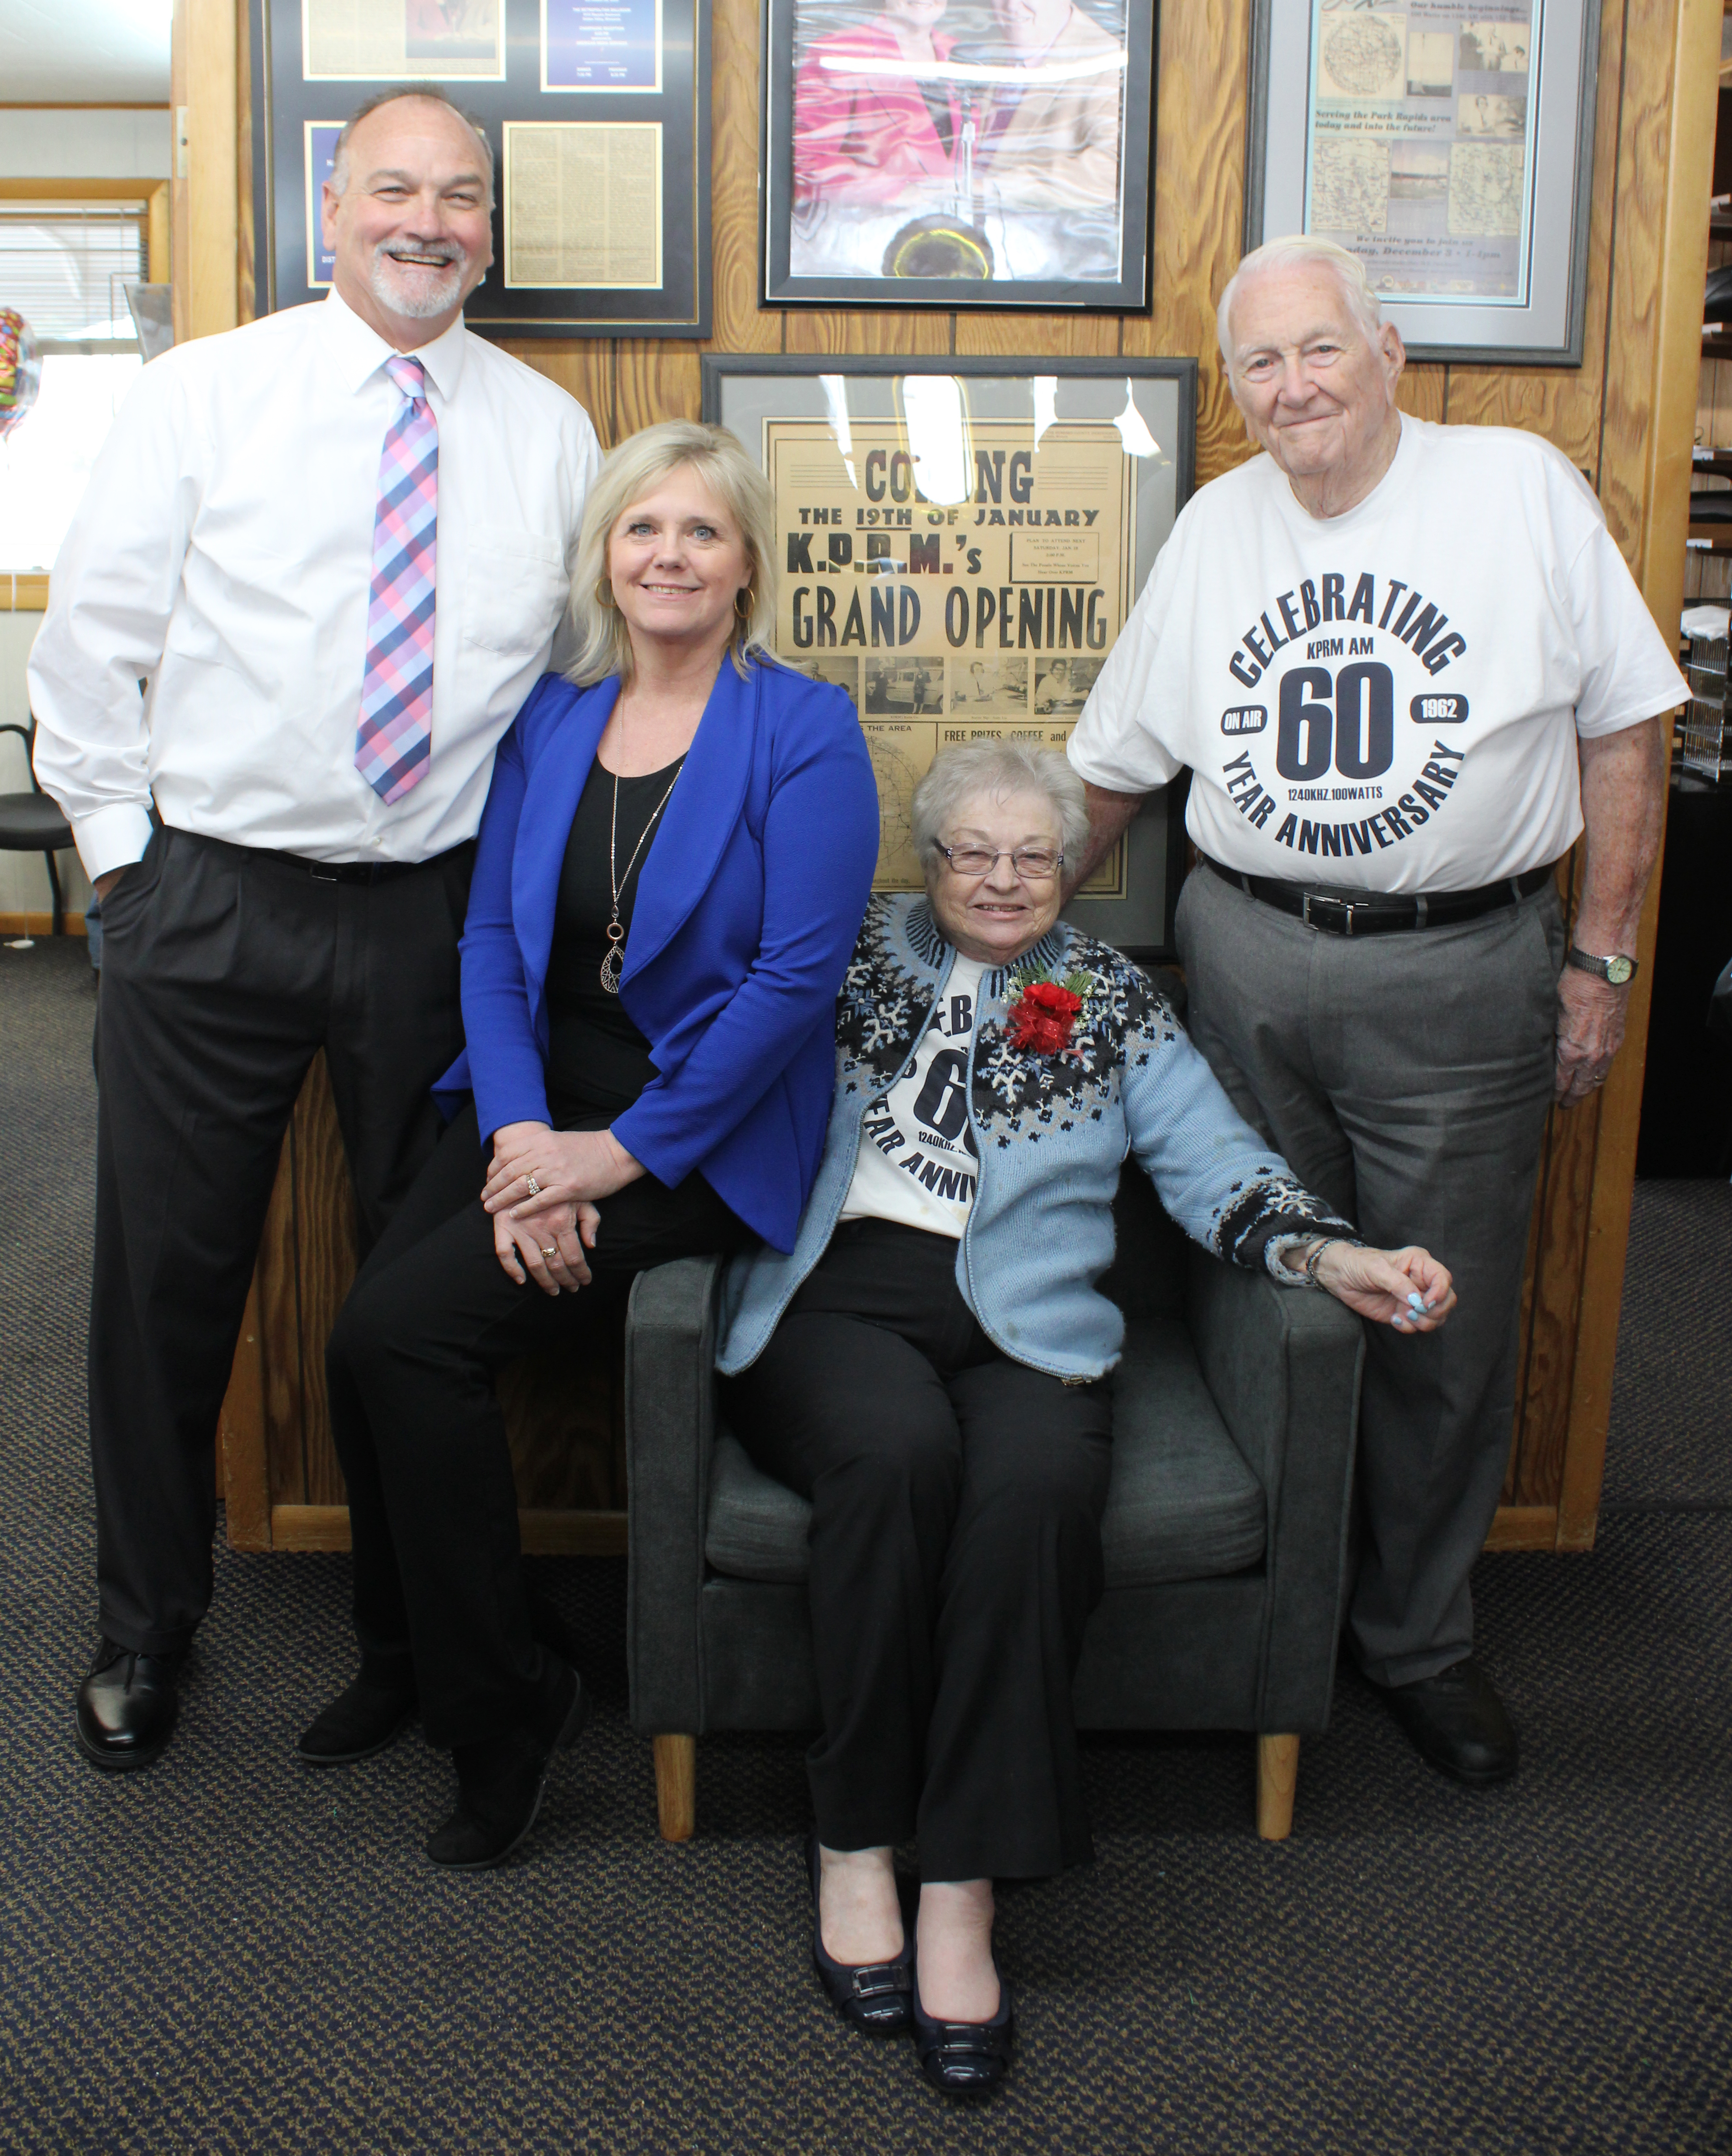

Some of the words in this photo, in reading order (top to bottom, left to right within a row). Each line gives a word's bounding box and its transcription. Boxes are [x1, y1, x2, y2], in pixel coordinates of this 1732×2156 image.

[1344, 122, 1362, 130] and
[1386, 123, 1400, 131] the
[1353, 111, 1367, 119] the
[866, 449, 1034, 504] CONG
[798, 508, 842, 525] THE
[856, 508, 912, 526] 19TH
[927, 508, 959, 526] OF
[973, 509, 1100, 527] JANUARY
[793, 585, 921, 648] GRAND
[945, 586, 1107, 650] OPENING
[1230, 572, 1467, 689] CELEBRATING
[1307, 638, 1343, 660] KPRM
[1348, 637, 1374, 655] AM
[1224, 712, 1241, 730] ON
[1242, 709, 1262, 729] AIR
[1420, 699, 1457, 719] 1962
[1276, 661, 1394, 781] 60
[945, 730, 966, 741] FREE
[1051, 730, 1067, 741] and
[1222, 750, 1276, 830] YEAR
[1275, 739, 1465, 857] ANNIVERSARY
[863, 1094, 905, 1156] EAR
